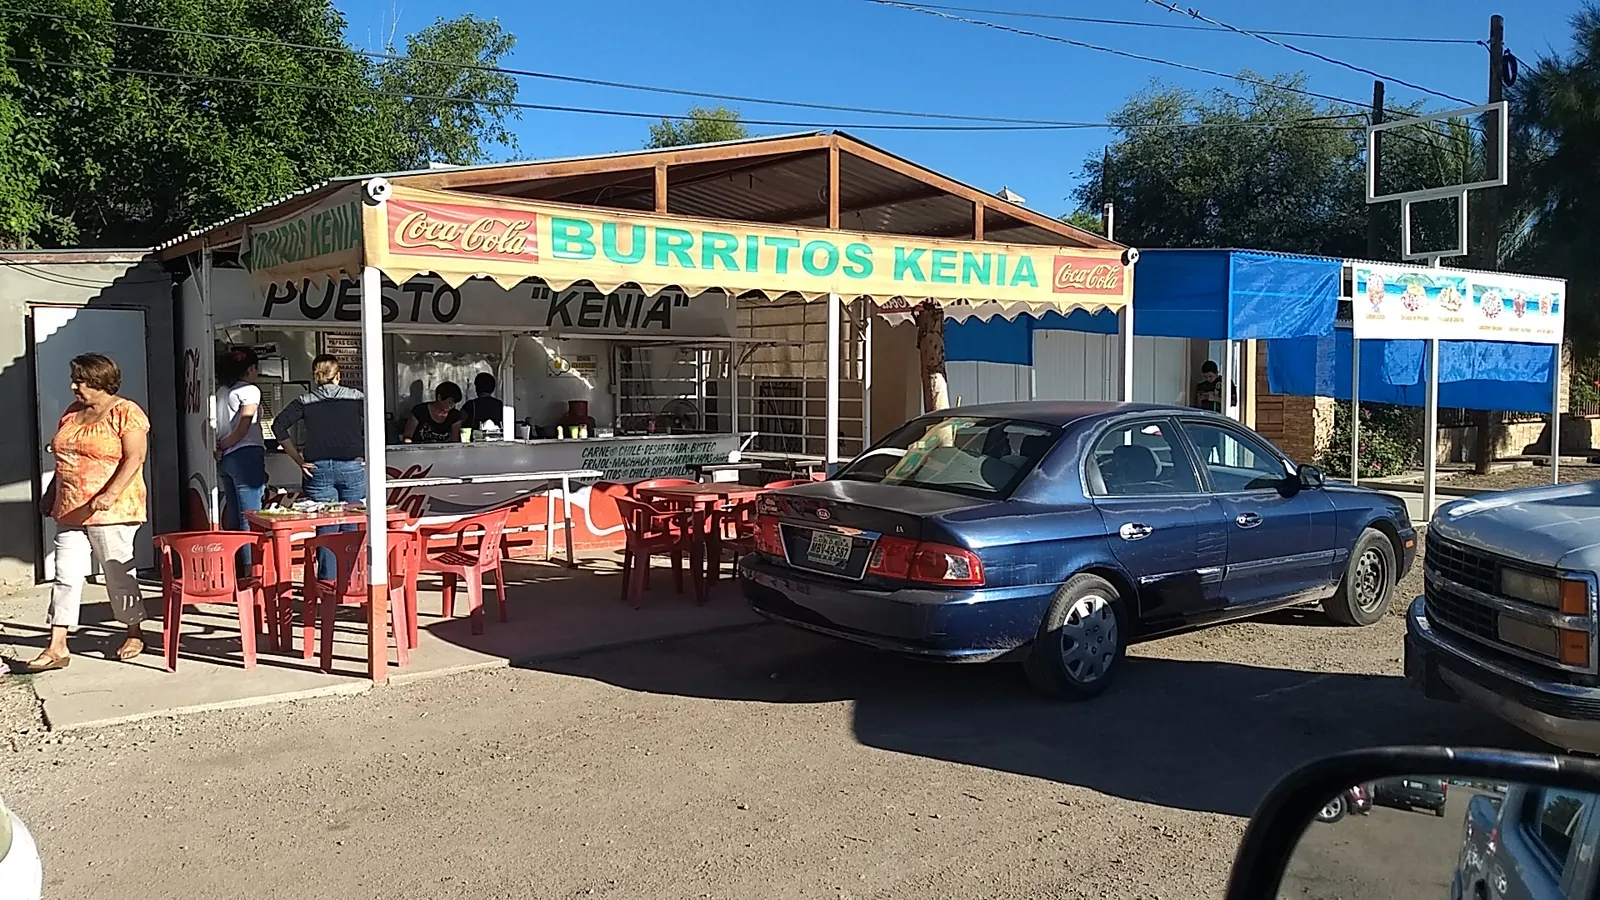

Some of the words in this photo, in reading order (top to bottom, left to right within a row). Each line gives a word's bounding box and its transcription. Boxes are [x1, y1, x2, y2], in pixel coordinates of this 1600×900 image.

[310, 200, 361, 257] KENIA
[395, 211, 532, 255] Coca-Cola
[551, 217, 874, 279] BURRITOS
[893, 246, 1039, 288] KENIA
[1055, 262, 1121, 290] Coca-Cola
[262, 277, 461, 323] PUESTO
[619, 444, 642, 457] CHILE
